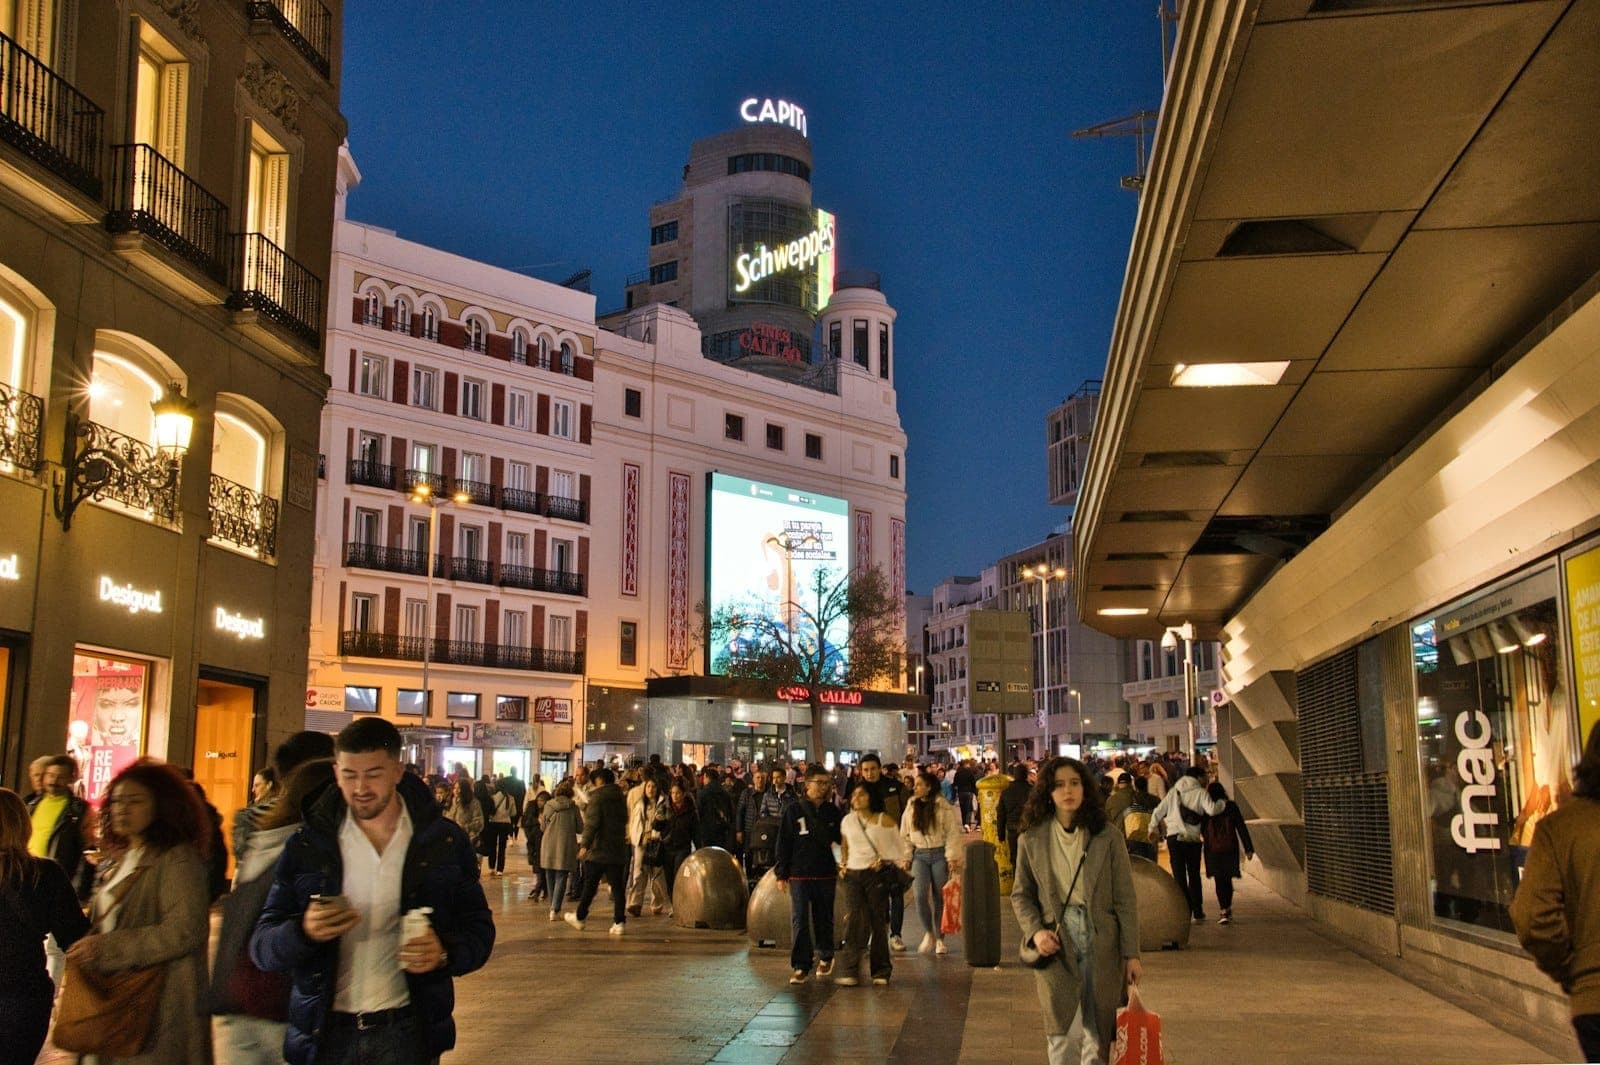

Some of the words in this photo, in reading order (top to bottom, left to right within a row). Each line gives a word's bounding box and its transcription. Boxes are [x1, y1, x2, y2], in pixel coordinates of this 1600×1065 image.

[736, 222, 834, 293] Schweppes
[820, 689, 862, 705] CALLAO
[94, 750, 113, 767] RE
[93, 770, 112, 783] BA
[1451, 710, 1501, 854] fnac
[797, 816, 809, 836] 1
